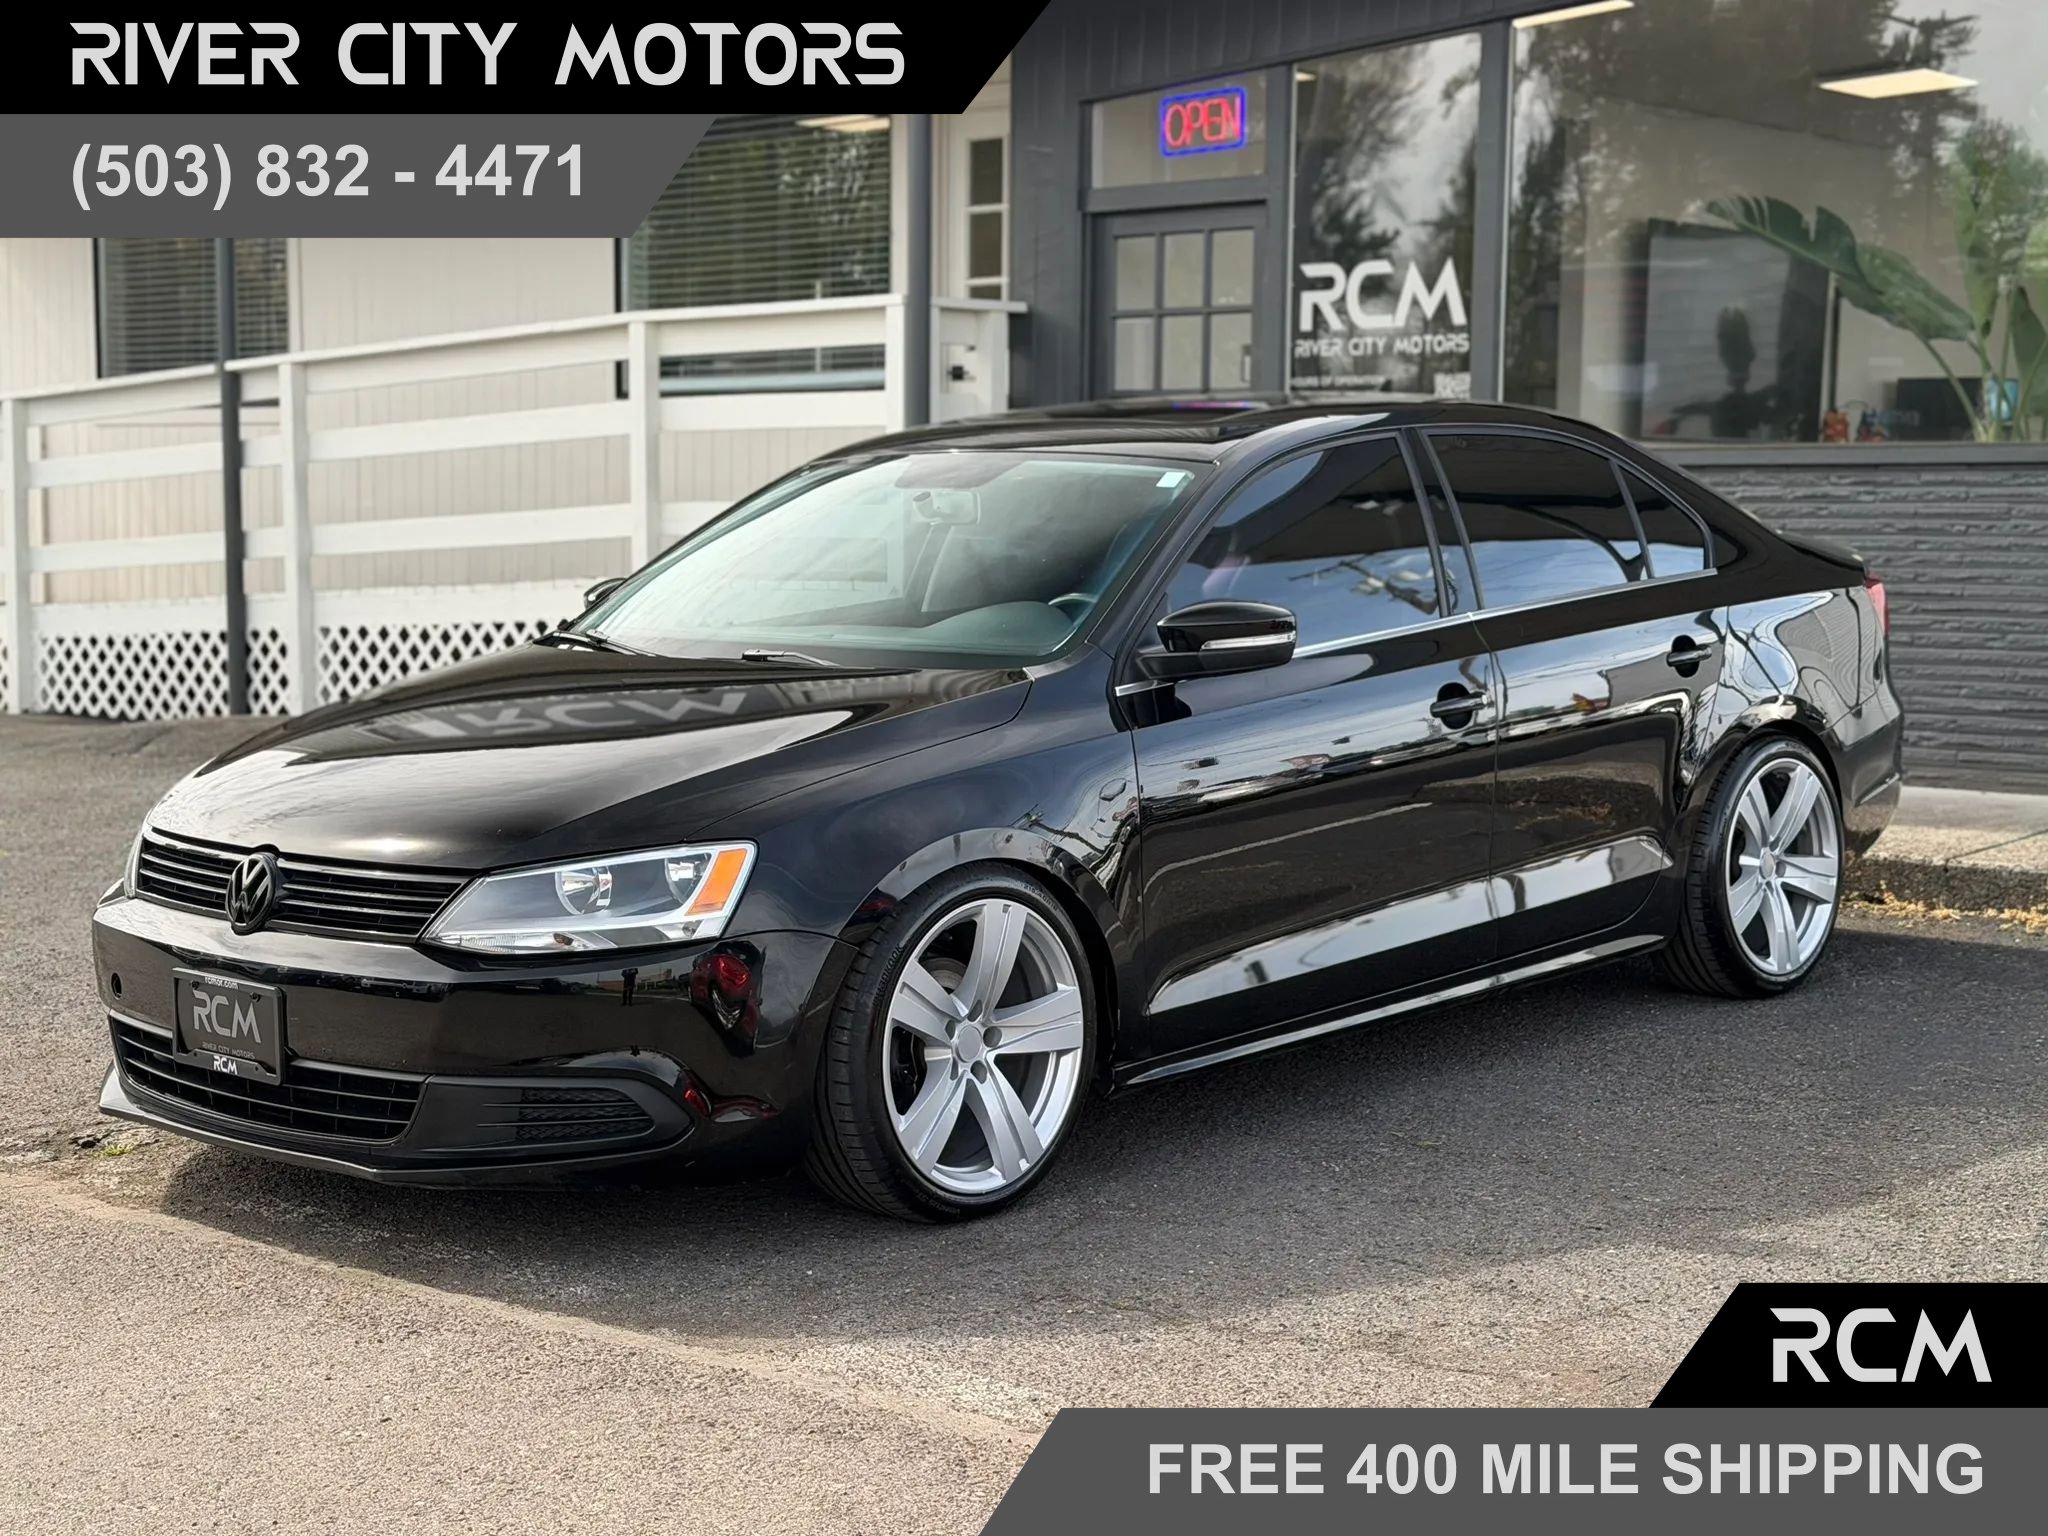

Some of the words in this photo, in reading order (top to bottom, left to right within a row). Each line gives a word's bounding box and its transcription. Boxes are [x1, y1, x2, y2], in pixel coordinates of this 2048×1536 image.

[1165, 97, 1241, 147] OPEN
[1300, 257, 1468, 332] RCM
[1294, 339, 1343, 358] RIVER
[1348, 336, 1387, 356] CITY
[1391, 333, 1470, 355] MOTORS
[193, 990, 261, 1043] RCM
[213, 1055, 238, 1075] RCM
